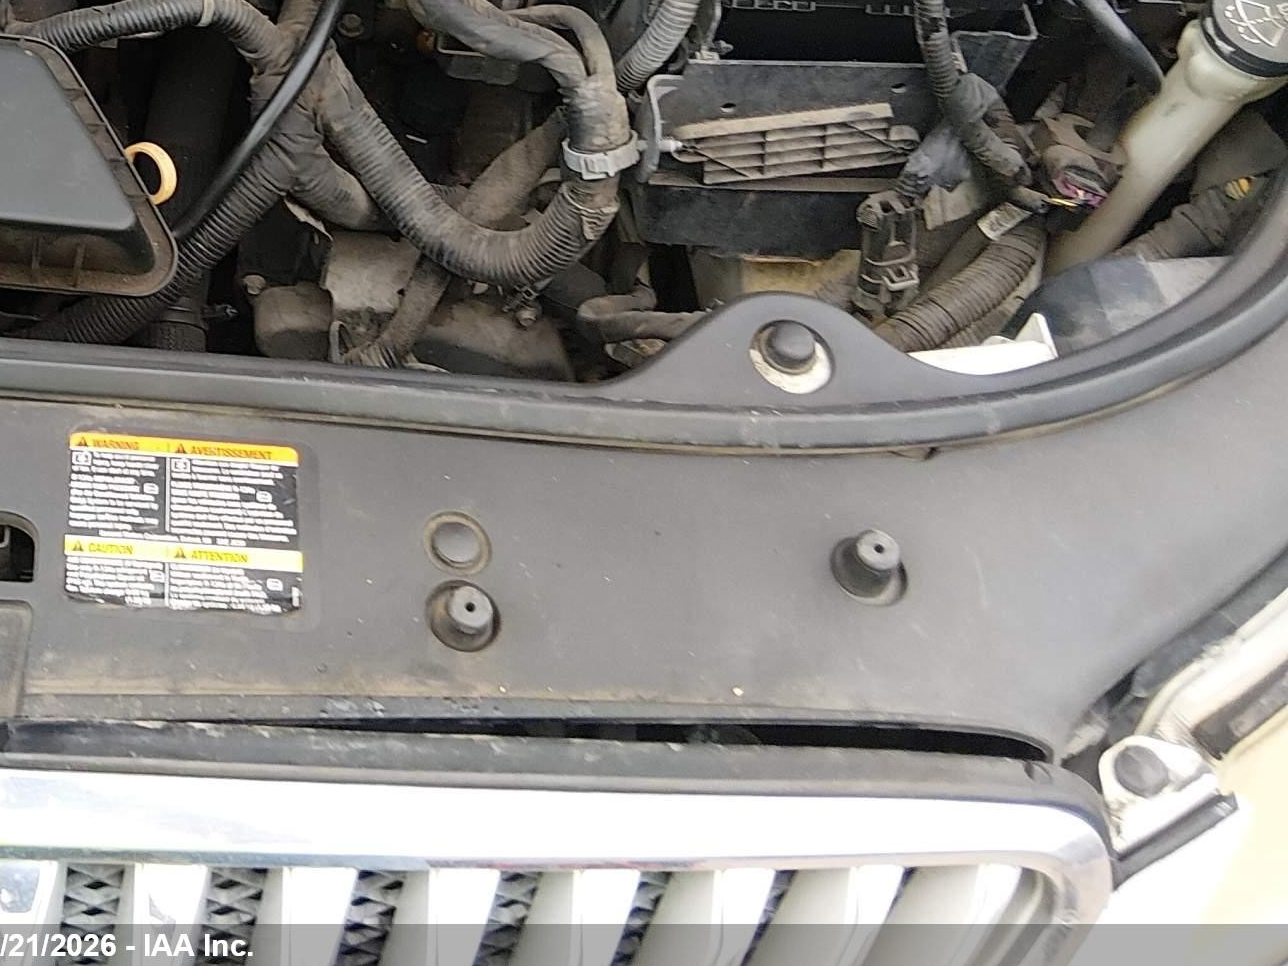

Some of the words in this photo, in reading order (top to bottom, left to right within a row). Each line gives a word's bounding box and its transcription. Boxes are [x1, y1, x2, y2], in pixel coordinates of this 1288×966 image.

[92, 438, 139, 450] WARNING
[190, 444, 272, 460] AVERTISSEMENT
[88, 542, 133, 554] CAUTION
[191, 550, 249, 563] ATTENTION
